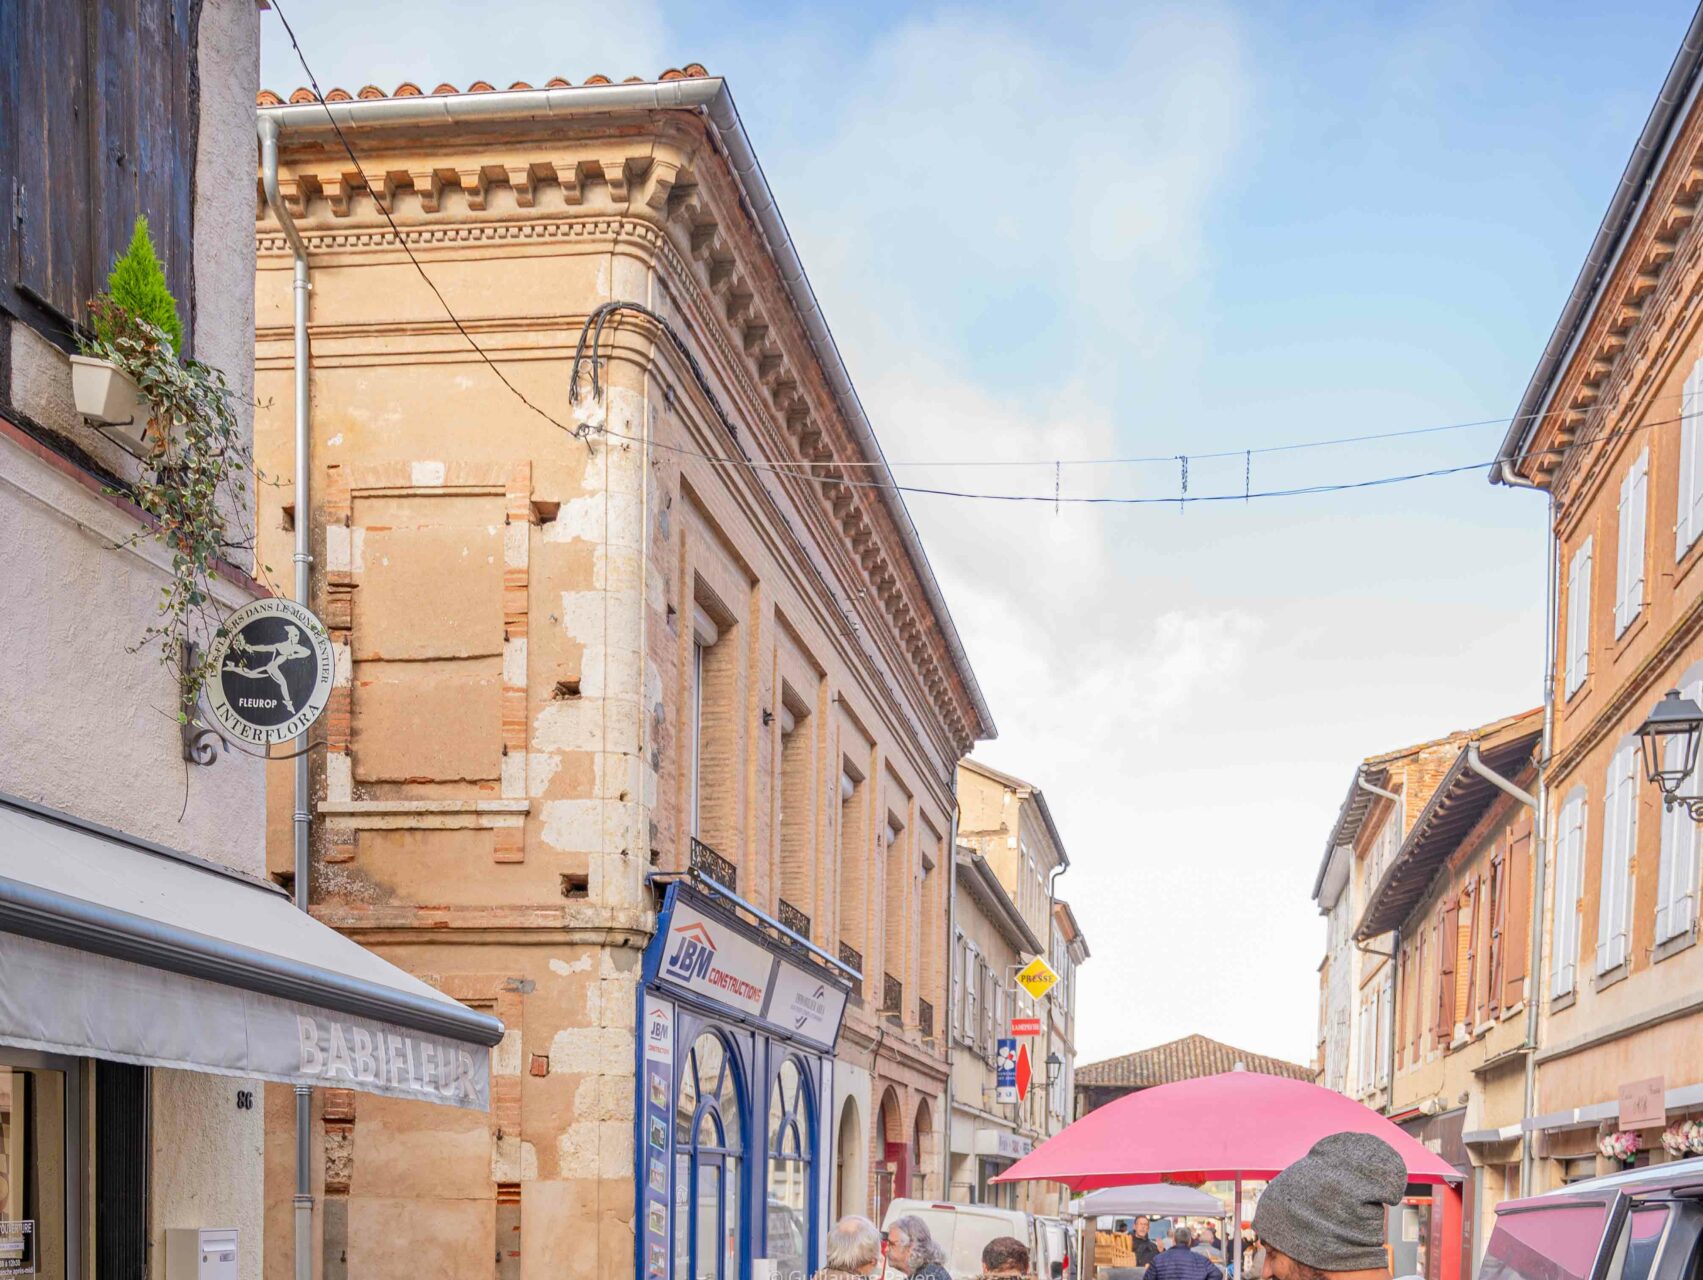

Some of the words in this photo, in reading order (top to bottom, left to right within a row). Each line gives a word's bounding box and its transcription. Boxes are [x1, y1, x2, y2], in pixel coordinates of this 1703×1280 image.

[245, 603, 273, 617] DANS
[318, 639, 330, 684] ENTIER
[215, 701, 321, 742] INTERFLORA
[238, 698, 278, 708] FLEUROP
[668, 936, 715, 981] JBM
[707, 967, 762, 1004] CONSTRUCTIONS
[1020, 974, 1054, 983] PRESSE
[296, 1014, 481, 1102] BABIFLEUR
[236, 1090, 254, 1110] 86
